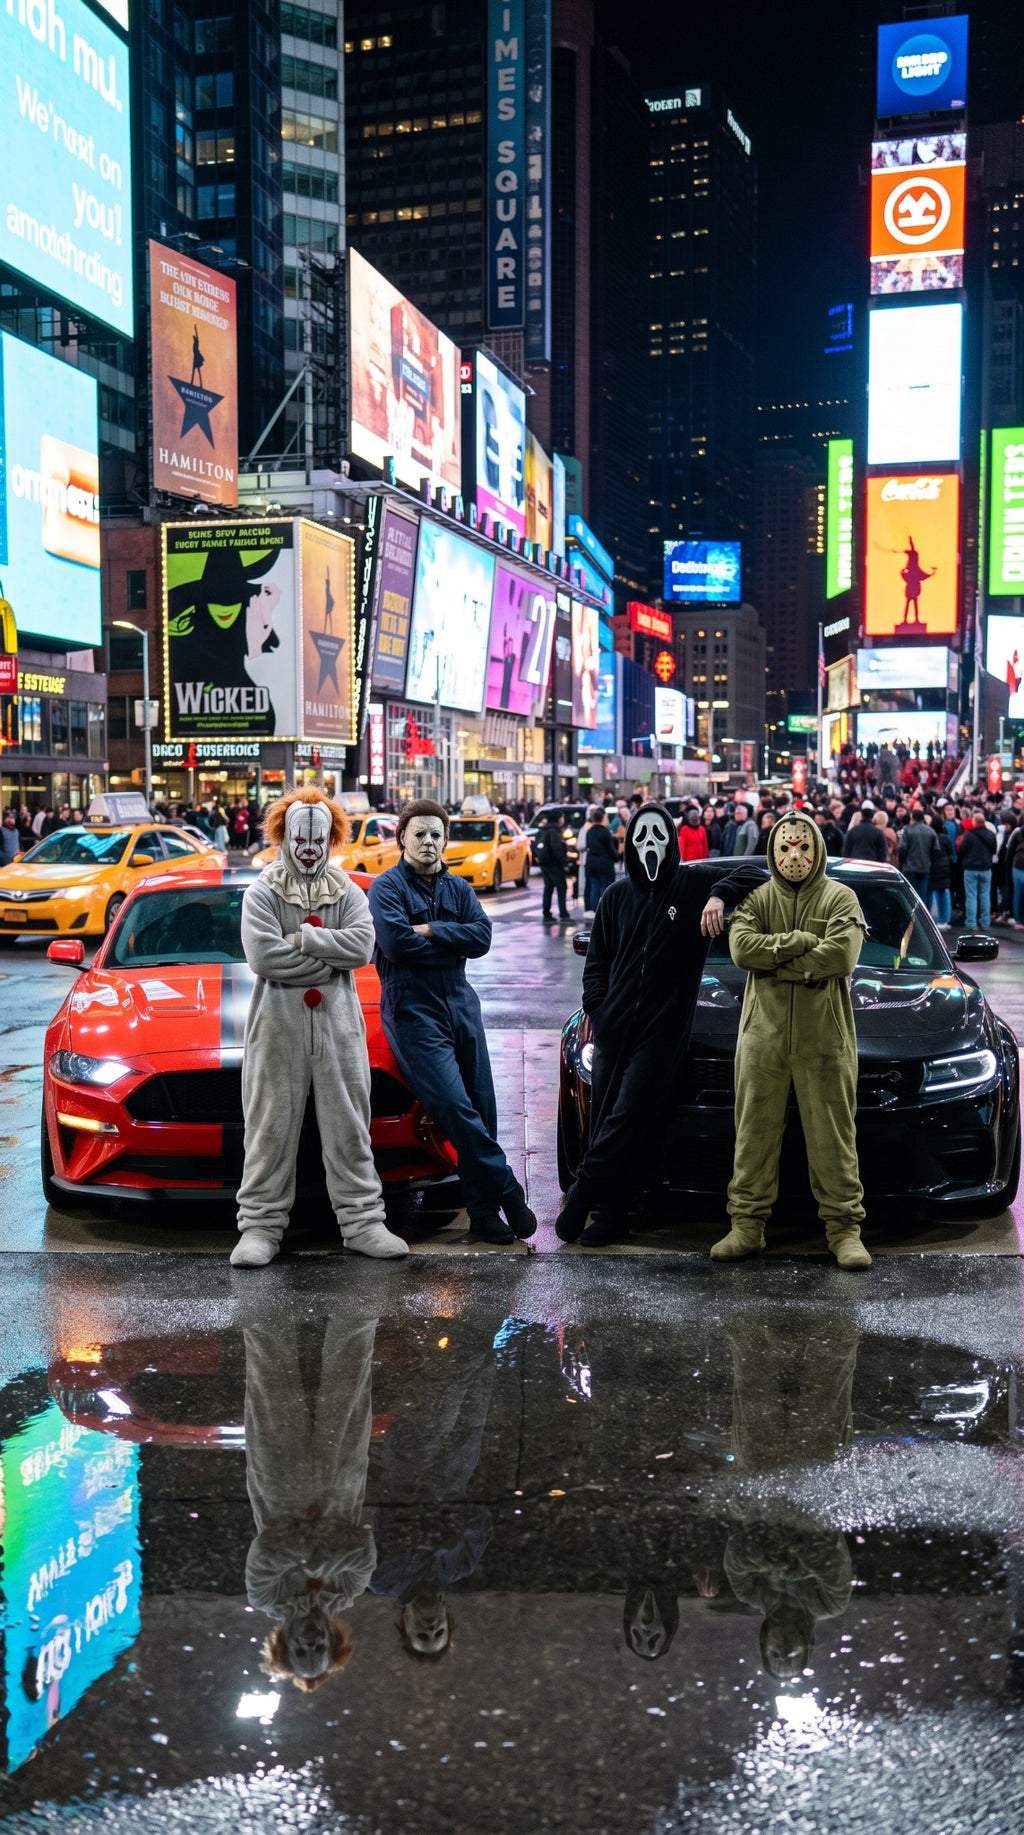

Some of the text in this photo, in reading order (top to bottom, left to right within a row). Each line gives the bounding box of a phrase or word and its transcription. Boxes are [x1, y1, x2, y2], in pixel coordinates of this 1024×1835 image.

[100, 152, 121, 190] on
[494, 0, 518, 309] IMES SQUARE
[181, 387, 213, 404] HAMILTON
[159, 447, 234, 483] HAMILTON
